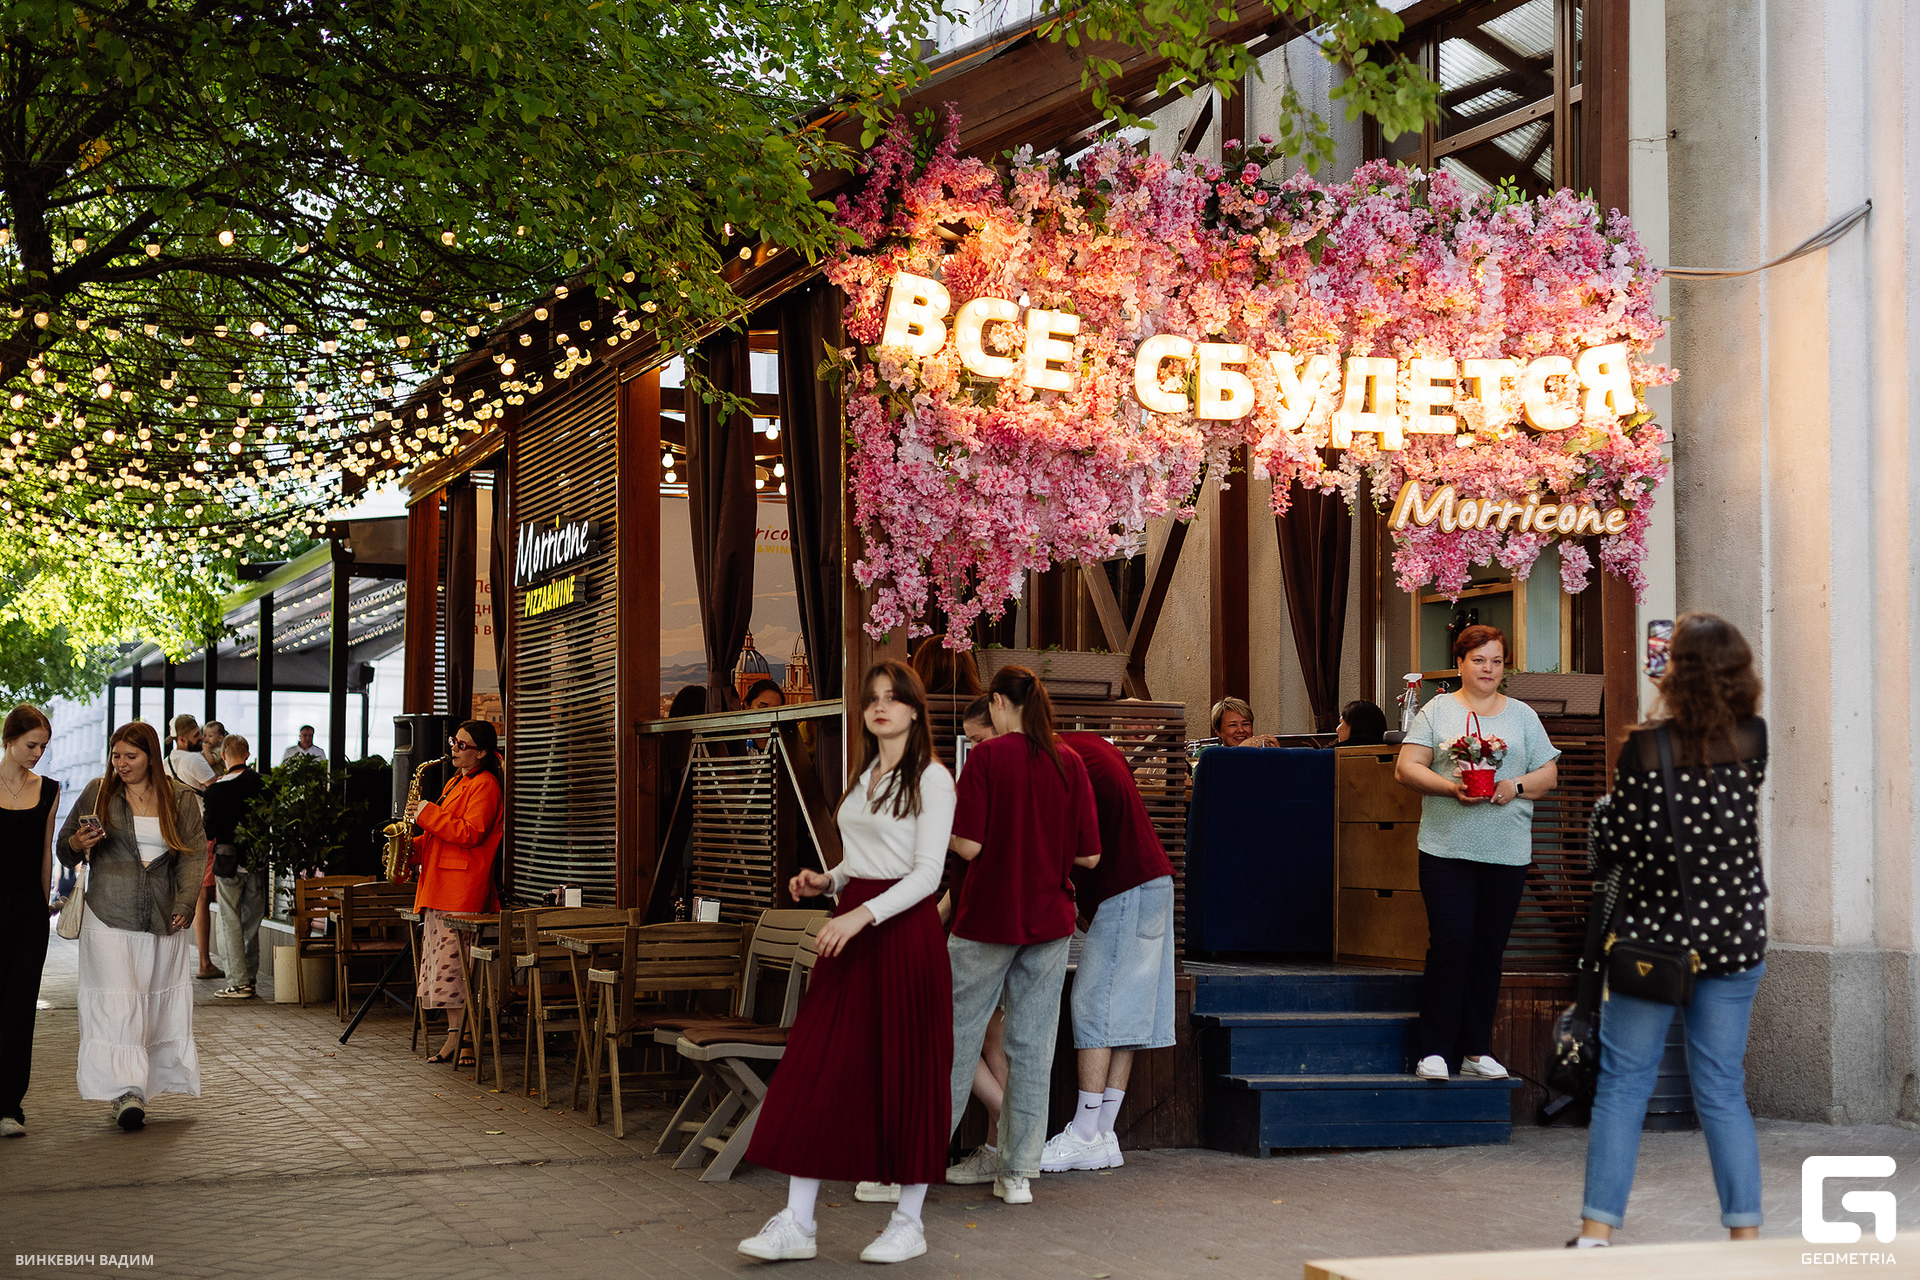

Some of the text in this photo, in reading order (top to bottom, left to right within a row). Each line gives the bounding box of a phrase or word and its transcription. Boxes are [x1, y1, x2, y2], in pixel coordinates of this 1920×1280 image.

[882, 271, 1636, 451] ВСЕ СБУДЕТСЯ
[755, 525, 791, 541] rico
[1388, 480, 1629, 535] Morricone
[514, 514, 589, 587] Morricone
[524, 574, 576, 618] PIZZA&WINE
